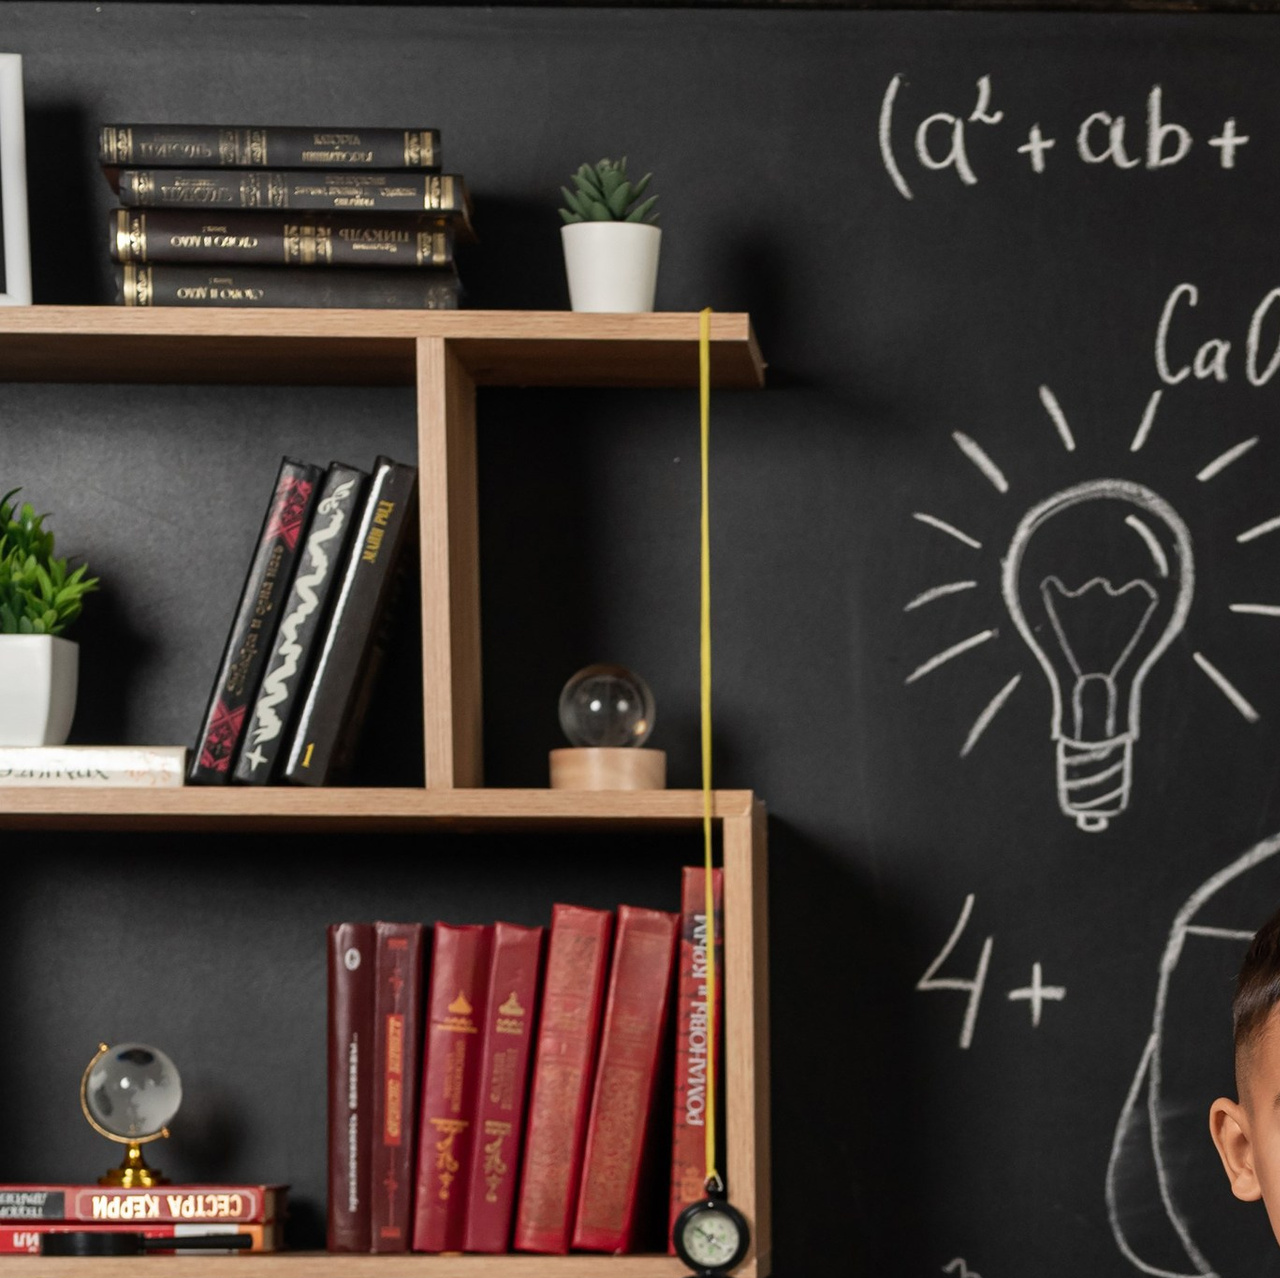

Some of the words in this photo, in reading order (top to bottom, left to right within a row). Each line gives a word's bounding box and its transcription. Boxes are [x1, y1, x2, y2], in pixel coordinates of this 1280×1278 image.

[685, 1001, 709, 1126] РОМАНОВЫ
[91, 1194, 160, 1219] КЕРРИ
[166, 1195, 243, 1219] СЕСТРА
